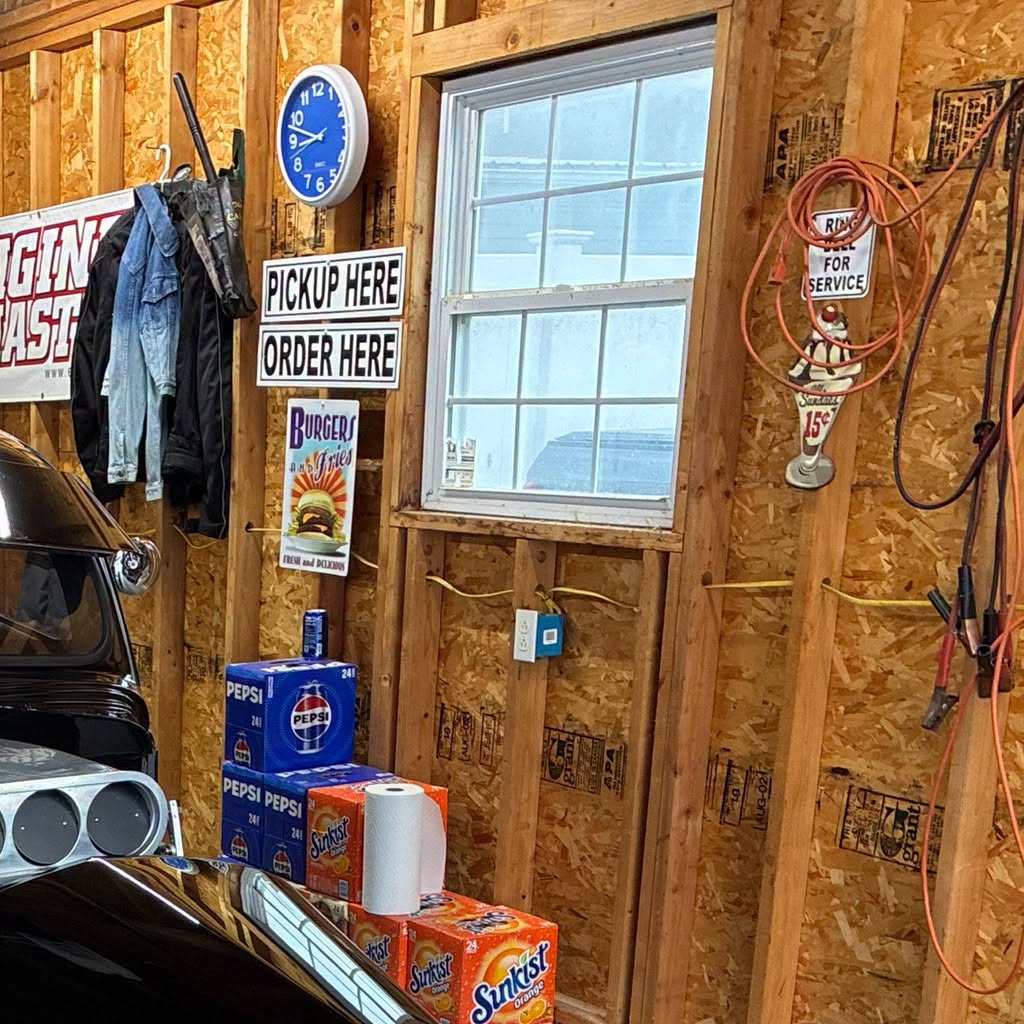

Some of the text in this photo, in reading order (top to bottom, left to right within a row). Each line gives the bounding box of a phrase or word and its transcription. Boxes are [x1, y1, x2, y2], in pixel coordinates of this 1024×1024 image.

[300, 89, 309, 106] 11
[311, 82, 324, 98] 12
[290, 110, 304, 126] 10
[288, 133, 298, 150] 9
[775, 128, 789, 180] APA
[293, 157, 302, 172] 8
[303, 173, 312, 189] 7
[315, 177, 325, 192] 6
[824, 256, 850, 272] FOR
[267, 259, 399, 312] PICKUP HERE
[809, 274, 864, 292] SERVICE
[264, 333, 396, 377] ORDER HERE
[289, 406, 356, 450] BURGERS
[289, 444, 353, 481] AND Fries
[226, 681, 263, 704] PEPSI
[293, 711, 329, 725] PEPSI
[562, 735, 575, 786] grant
[604, 749, 615, 791] APA
[224, 777, 261, 803] PEPSI
[264, 791, 302, 819] PEPSI
[310, 817, 350, 860] Sunkist
[902, 804, 921, 865] grant
[365, 935, 391, 964] kist
[410, 951, 453, 994] Sunkist
[513, 979, 545, 1009] Orange
